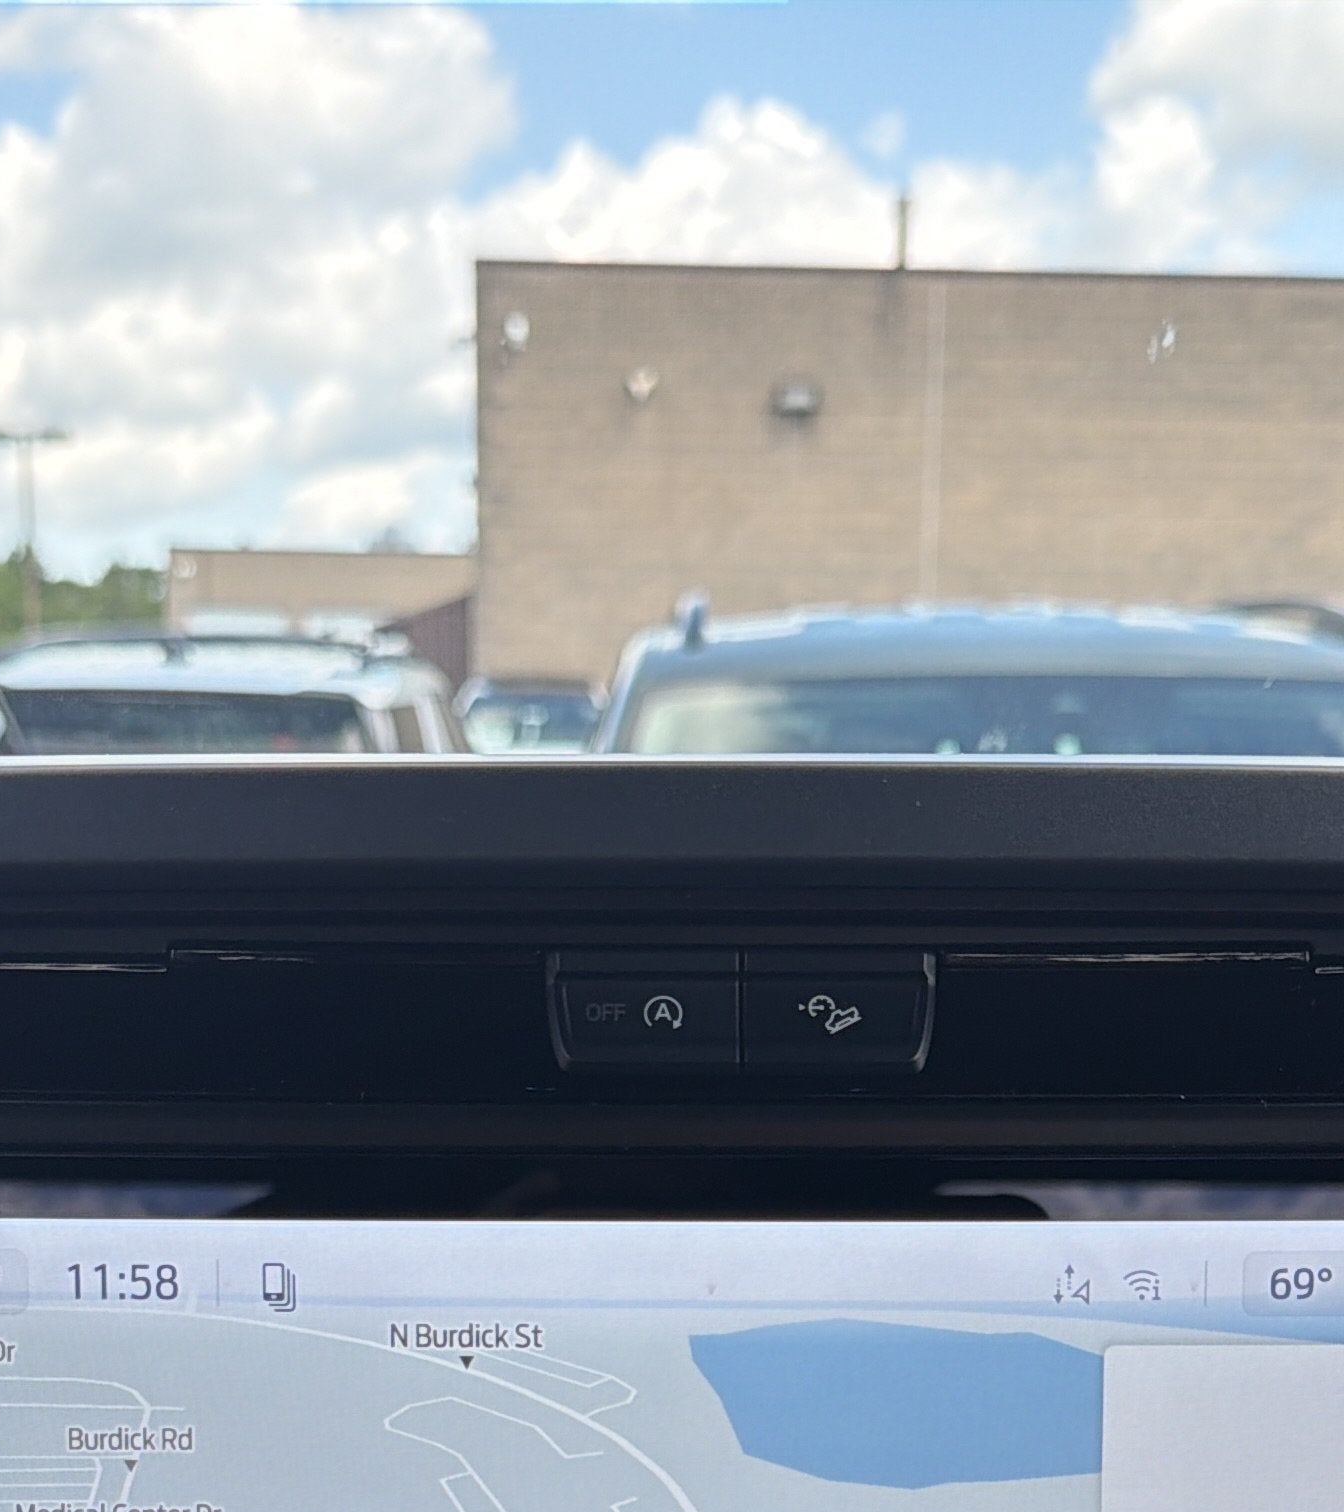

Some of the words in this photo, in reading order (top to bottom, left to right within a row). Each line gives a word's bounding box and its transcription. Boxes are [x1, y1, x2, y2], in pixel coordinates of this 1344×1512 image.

[585, 1003, 627, 1022] OFF
[66, 1264, 180, 1301] 11:58
[1269, 1267, 1333, 1300] 69°
[389, 1325, 409, 1348] N
[414, 1323, 510, 1349] Burdick
[515, 1325, 544, 1349] St
[67, 1427, 156, 1453] Burdick
[160, 1428, 193, 1452] Rd
